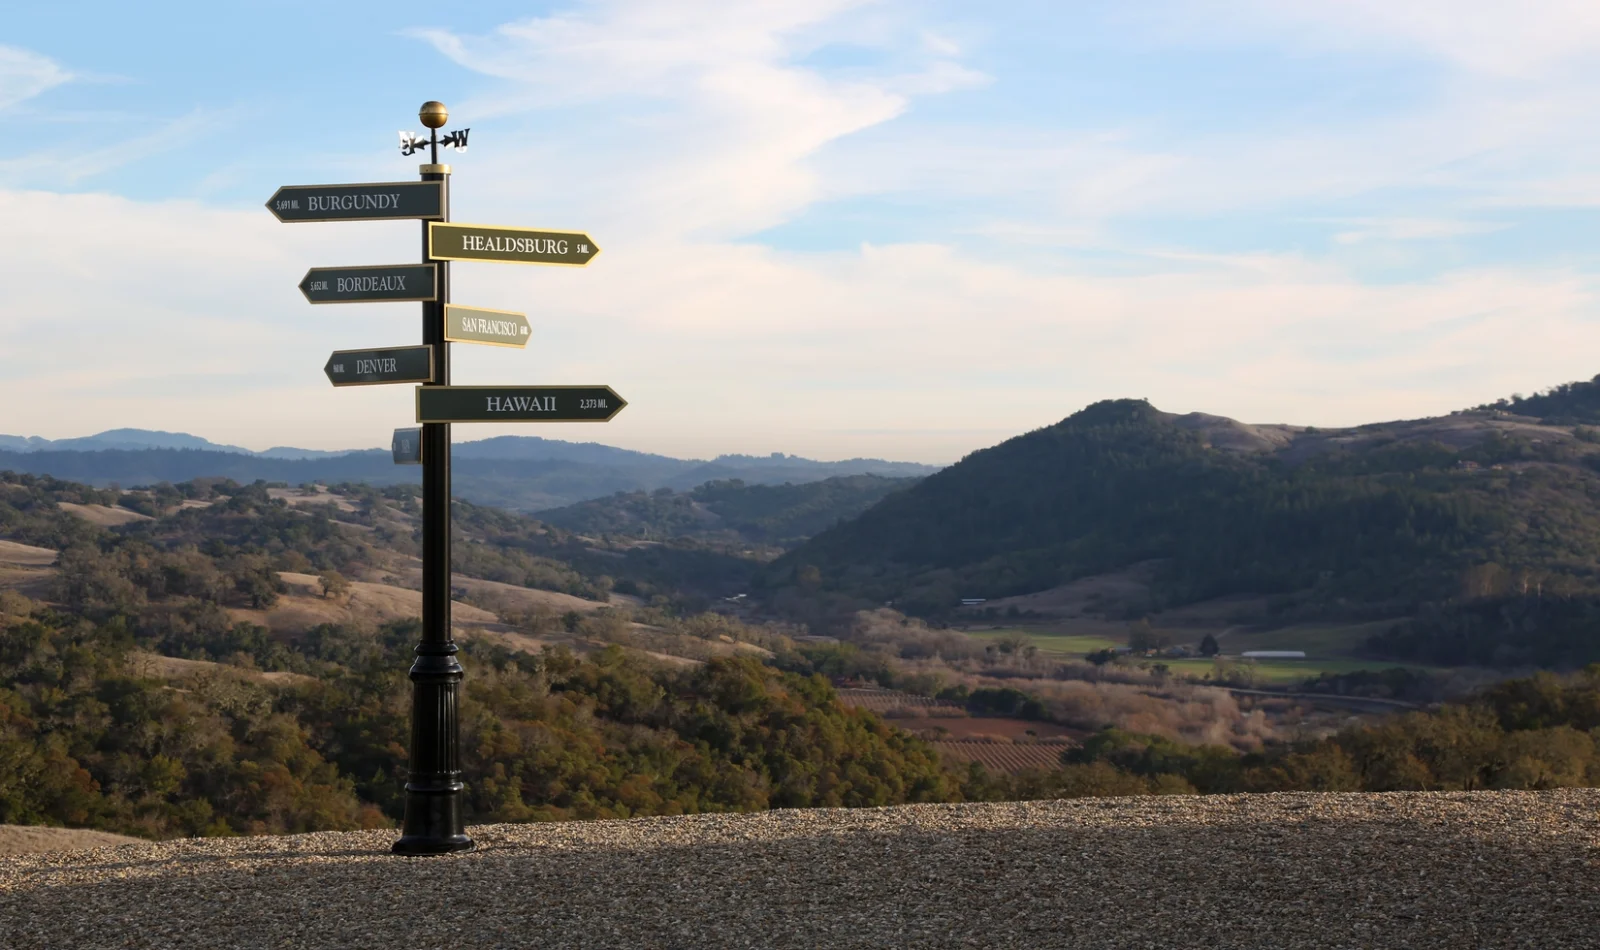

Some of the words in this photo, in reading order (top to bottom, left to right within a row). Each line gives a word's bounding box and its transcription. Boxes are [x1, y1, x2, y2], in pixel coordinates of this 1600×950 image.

[307, 193, 401, 211] BURGUNDY
[462, 235, 568, 255] HEALDSBURG
[337, 275, 406, 292] BORDEAUX
[462, 317, 477, 332] SAN
[478, 319, 517, 336] FRANCISCO
[356, 358, 397, 374] DENVER
[486, 396, 557, 412] HAWAII
[580, 399, 597, 410] 2,373
[597, 399, 608, 409] MI.
